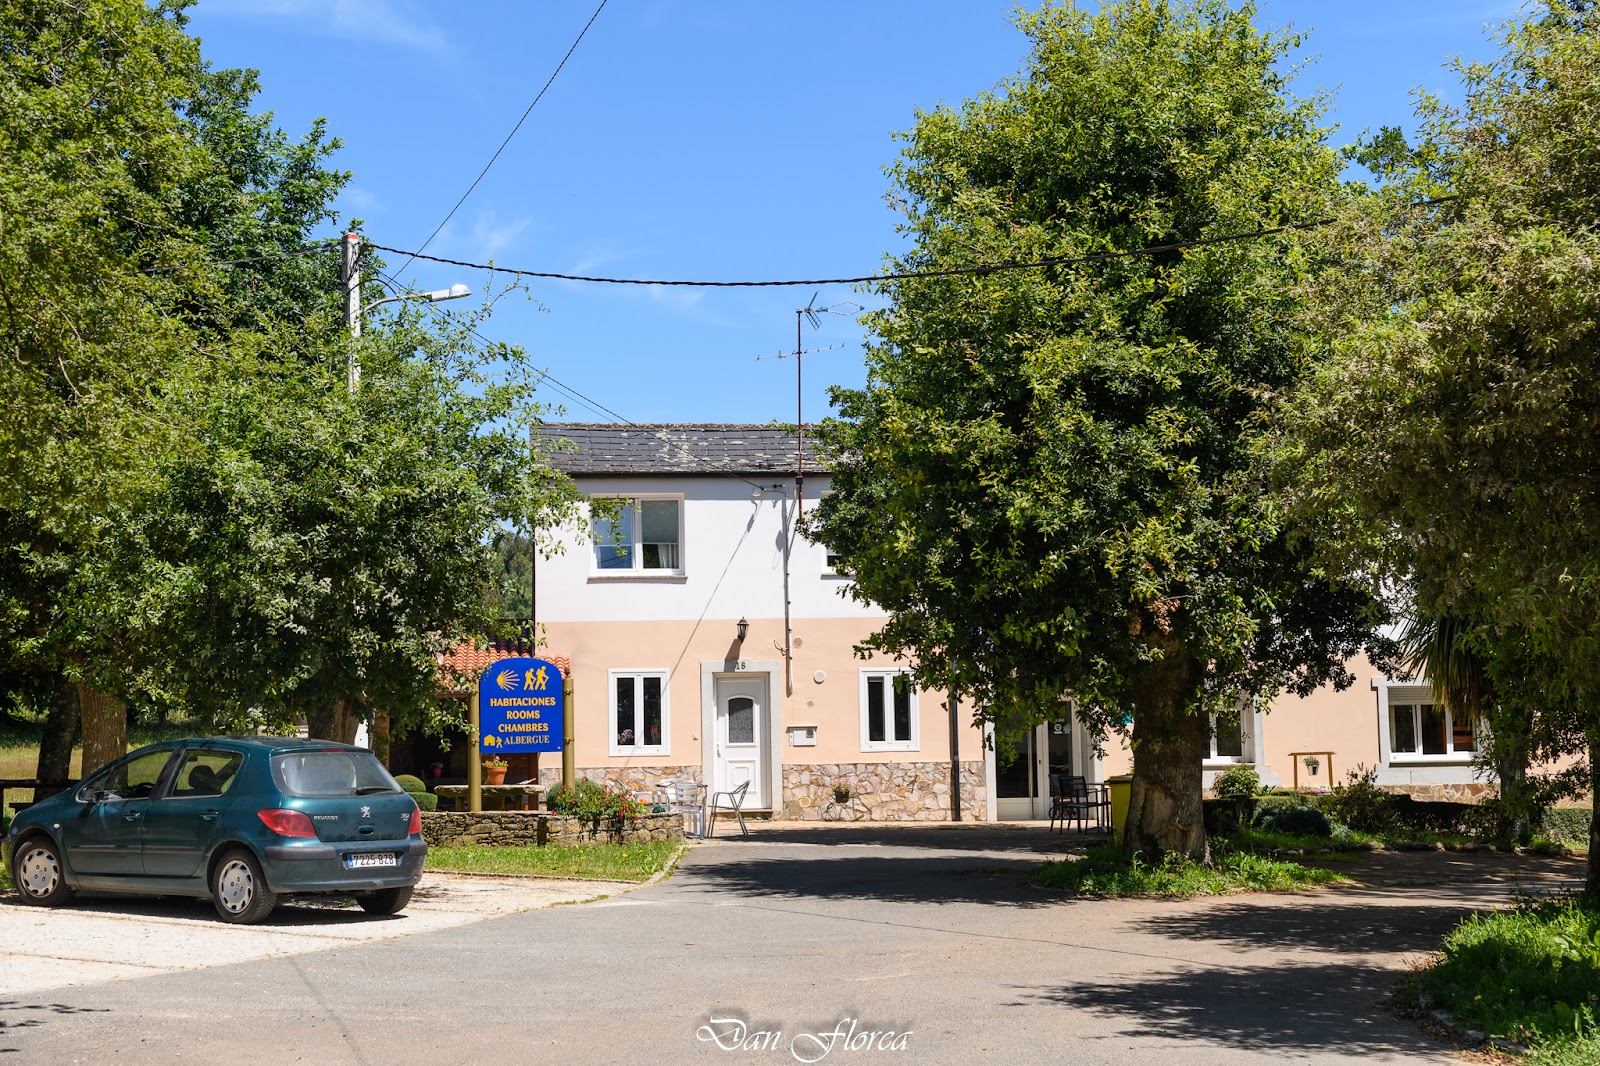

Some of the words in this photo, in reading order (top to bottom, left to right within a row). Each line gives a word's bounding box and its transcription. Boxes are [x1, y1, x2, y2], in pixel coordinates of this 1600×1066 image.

[490, 697, 556, 707] HABITACIONES
[506, 710, 541, 720] ROOMS
[497, 723, 549, 733] CHAMBRES
[504, 735, 550, 745] ALBERGUE
[353, 854, 376, 866] 7225
[377, 854, 394, 865] BZB
